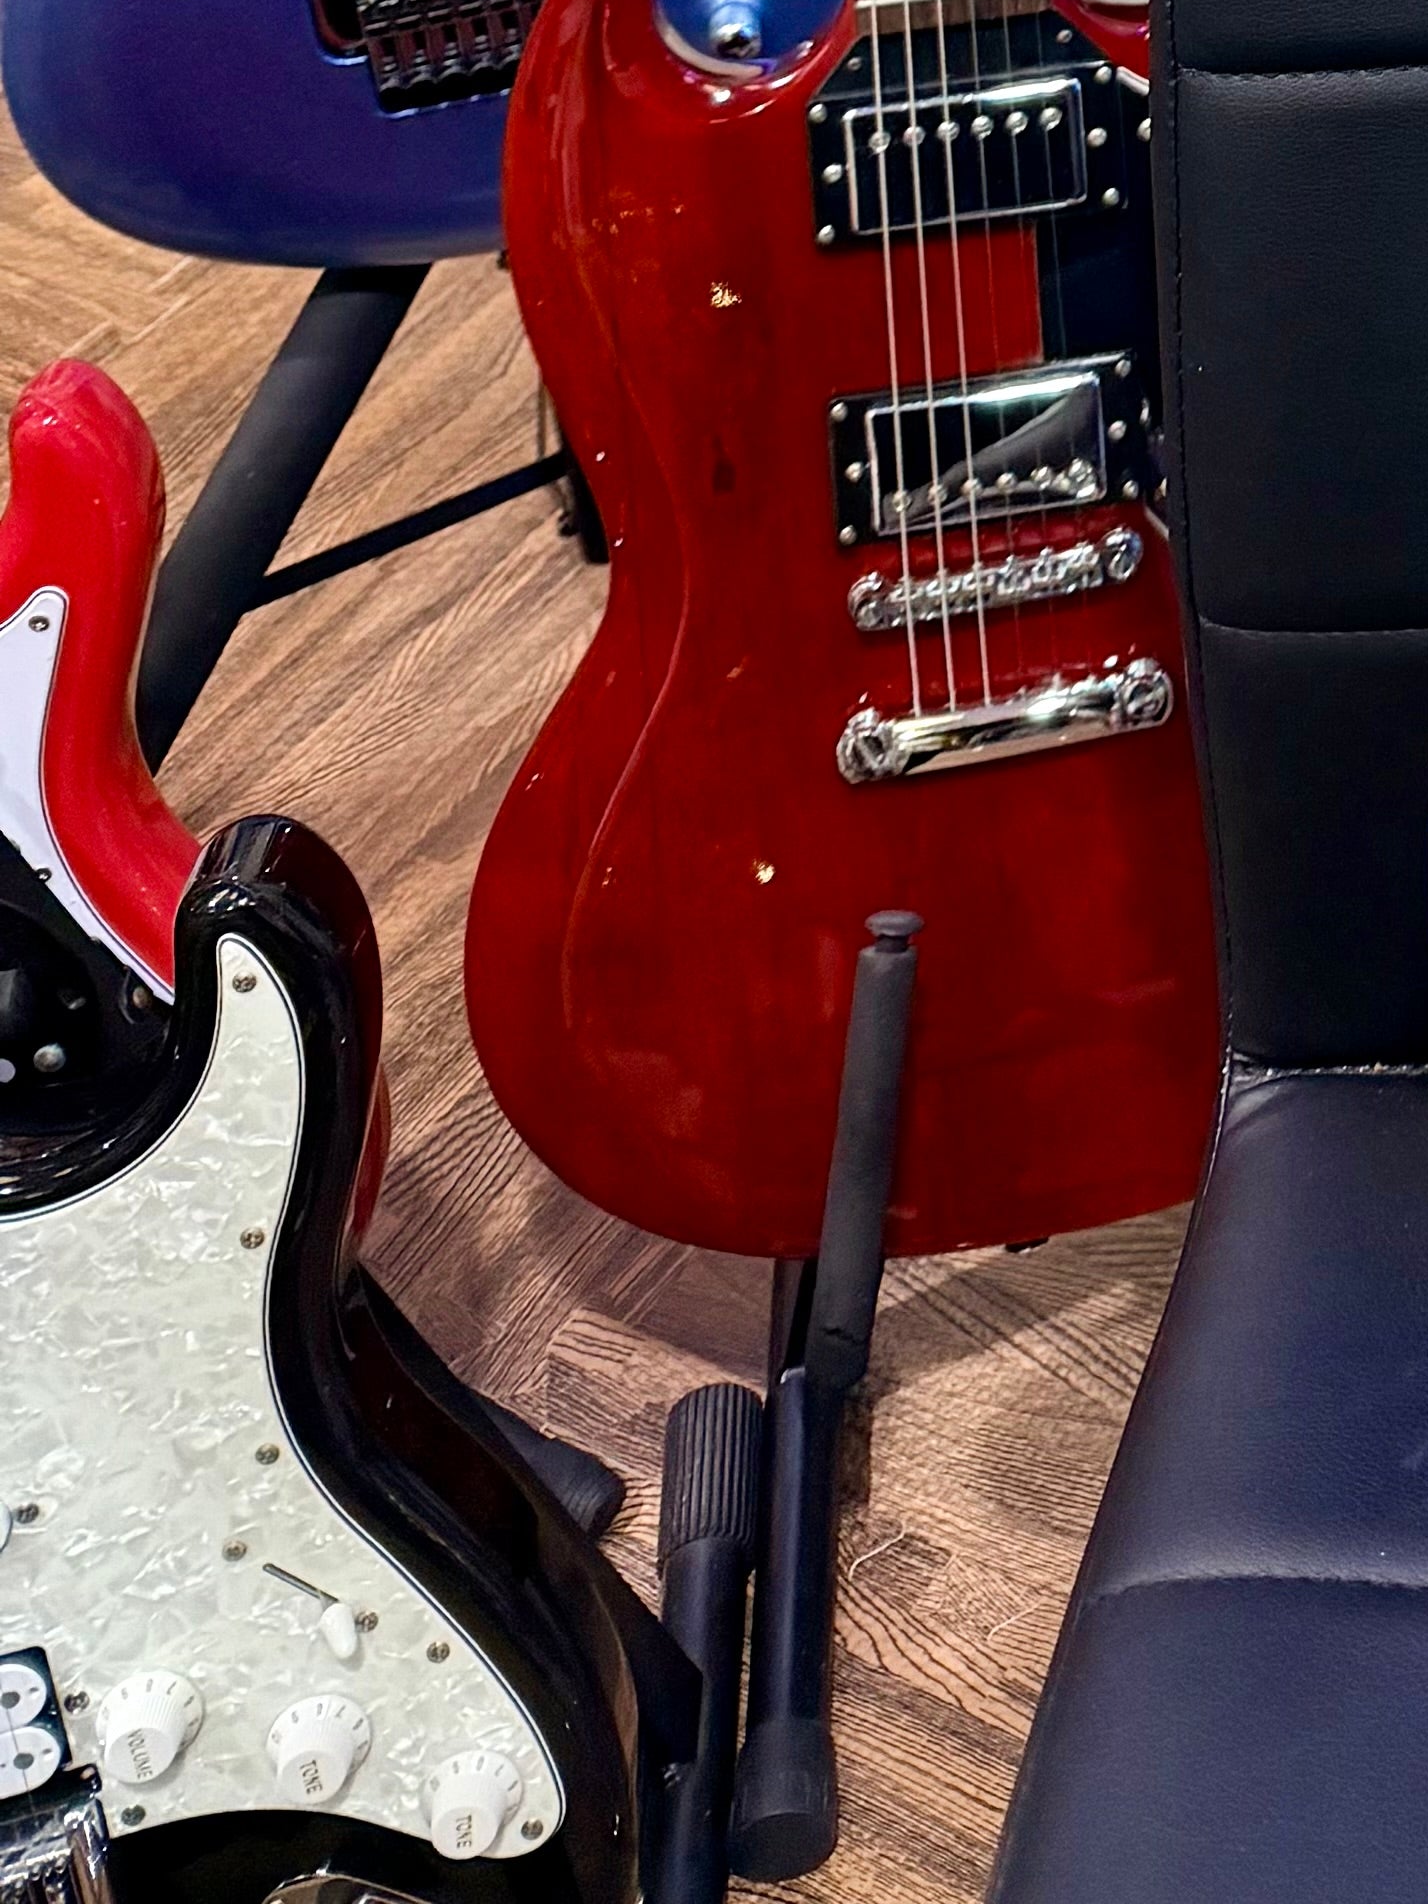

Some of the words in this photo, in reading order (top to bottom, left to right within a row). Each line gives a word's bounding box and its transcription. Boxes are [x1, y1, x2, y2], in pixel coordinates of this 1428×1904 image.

[128, 1728, 153, 1779] VOLUME
[300, 1759, 323, 1794] TONE
[455, 1814, 472, 1848] TONE
